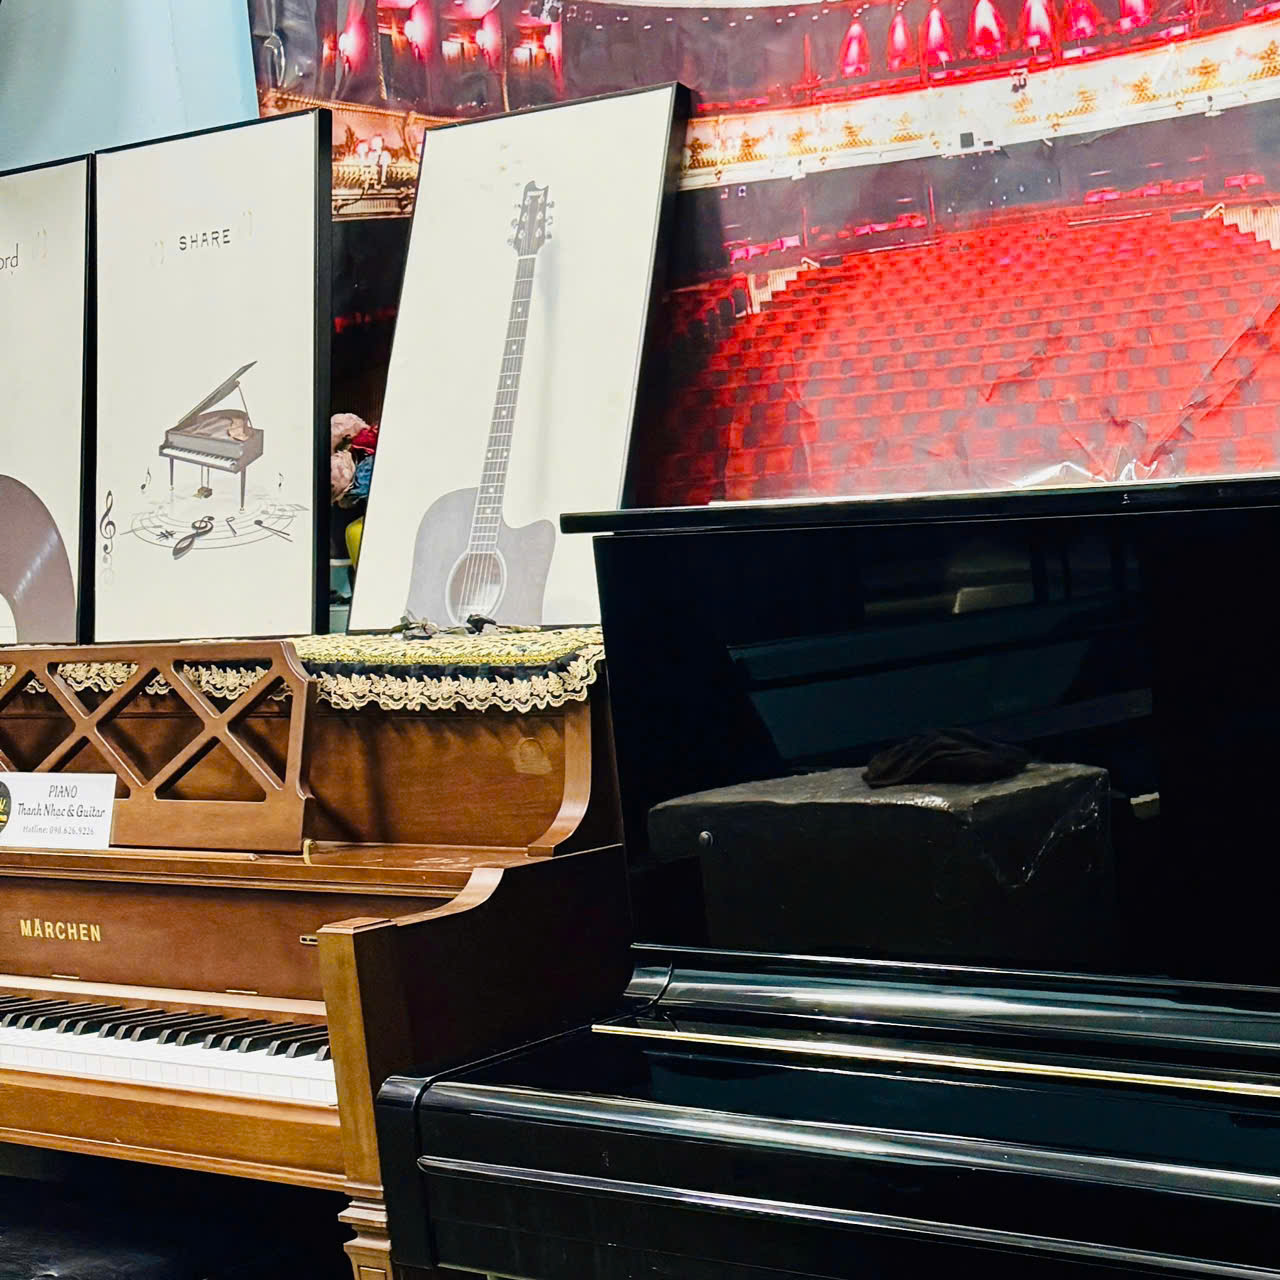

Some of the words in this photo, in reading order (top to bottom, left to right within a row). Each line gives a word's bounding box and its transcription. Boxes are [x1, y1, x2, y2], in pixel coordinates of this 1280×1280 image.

[178, 229, 231, 251] SHARE
[48, 784, 78, 799] PIANO
[17, 802, 42, 816] Thanh
[66, 804, 75, 817] &
[76, 804, 105, 818] Guitar
